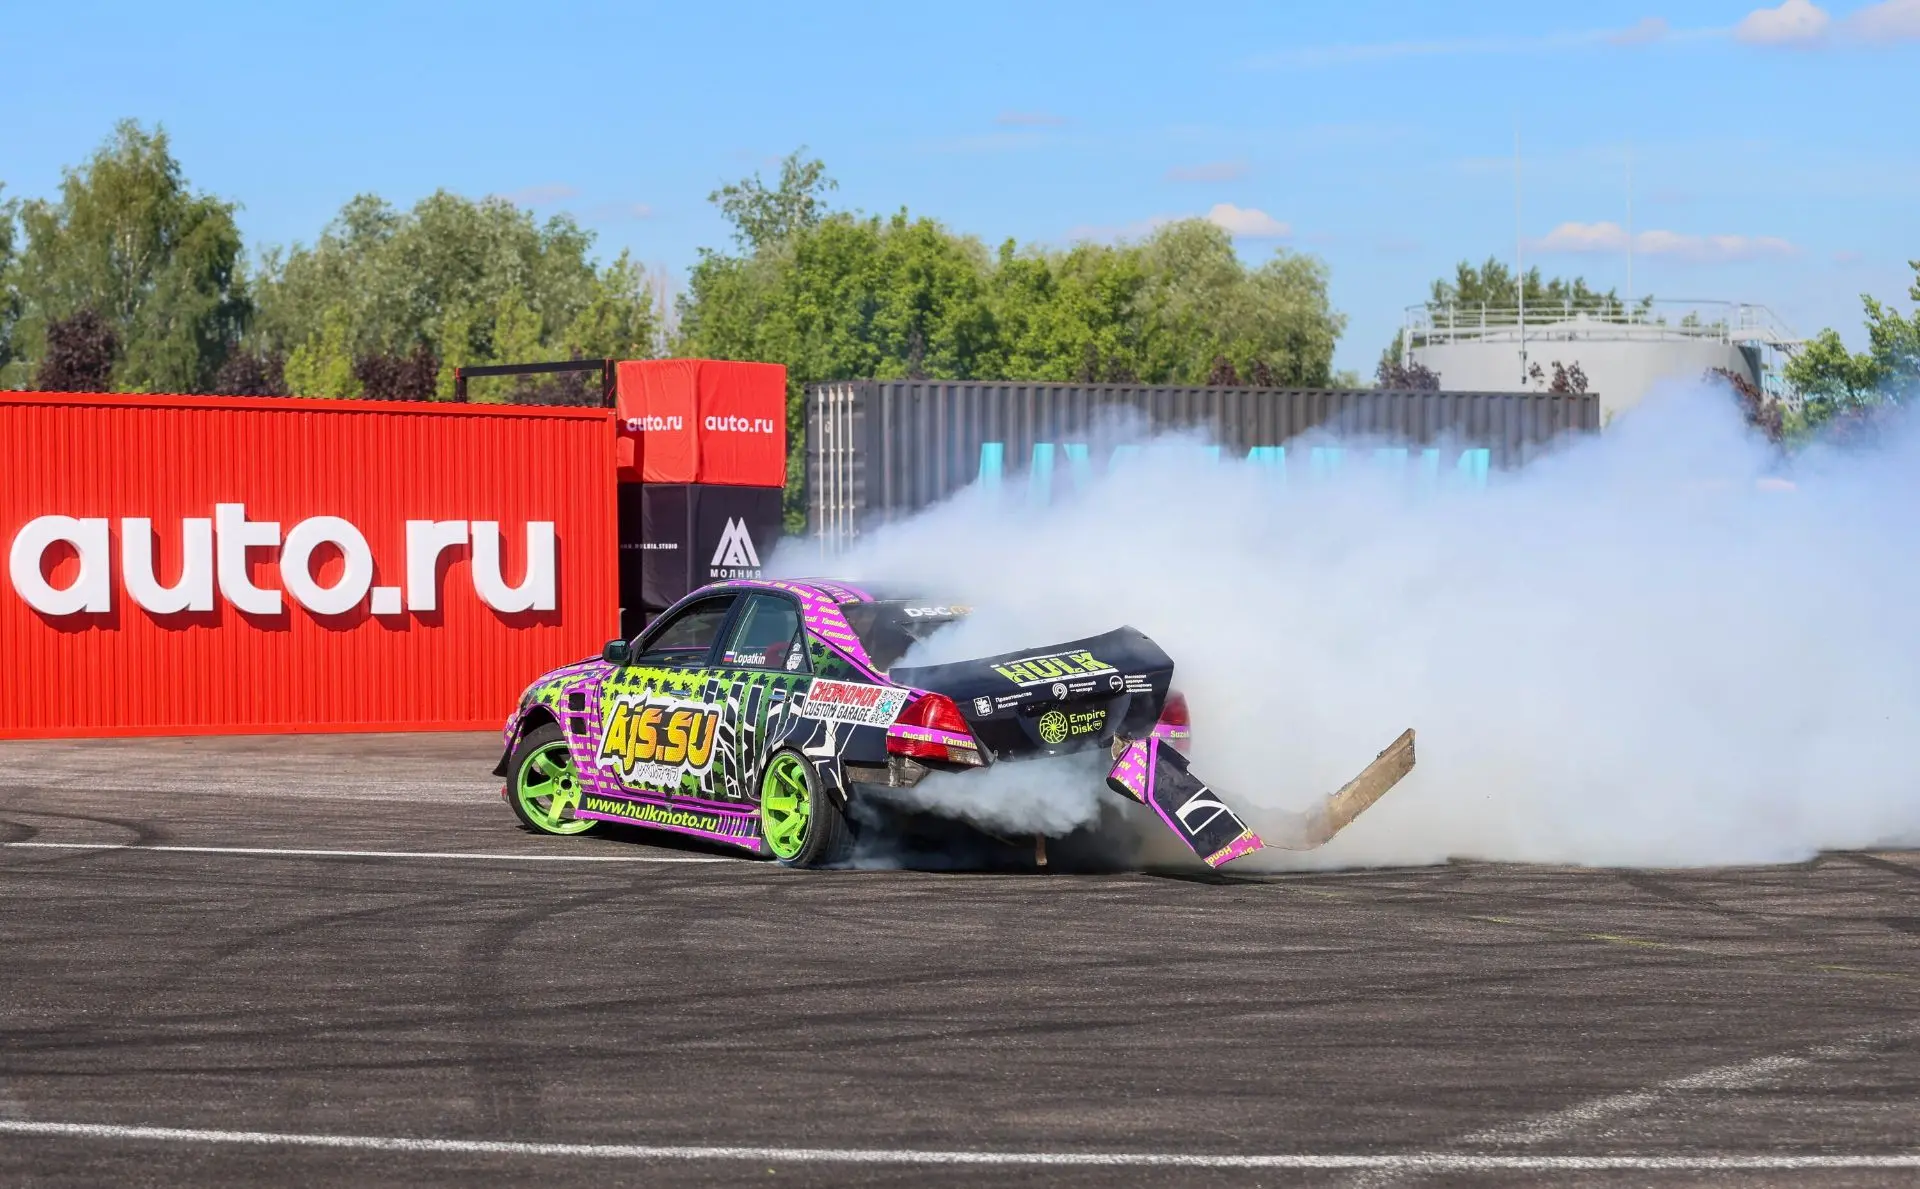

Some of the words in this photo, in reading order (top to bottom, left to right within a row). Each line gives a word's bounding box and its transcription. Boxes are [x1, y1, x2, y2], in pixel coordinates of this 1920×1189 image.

[626, 414, 683, 431] auto.ru
[705, 415, 774, 434] auto.ru
[9, 503, 556, 615] auto.ru
[710, 568, 762, 578] МОЛНИЯ
[733, 651, 766, 666] Lopatkin
[994, 652, 1113, 684] HULK
[809, 681, 883, 708] CHERNOMOR
[804, 701, 837, 719] CUSTOM
[836, 705, 871, 723] GARAGE
[1070, 710, 1106, 723] Empire
[902, 731, 933, 742] Ducati
[1071, 722, 1093, 735] Disk
[586, 797, 717, 832] www.hulkmoto.ru
